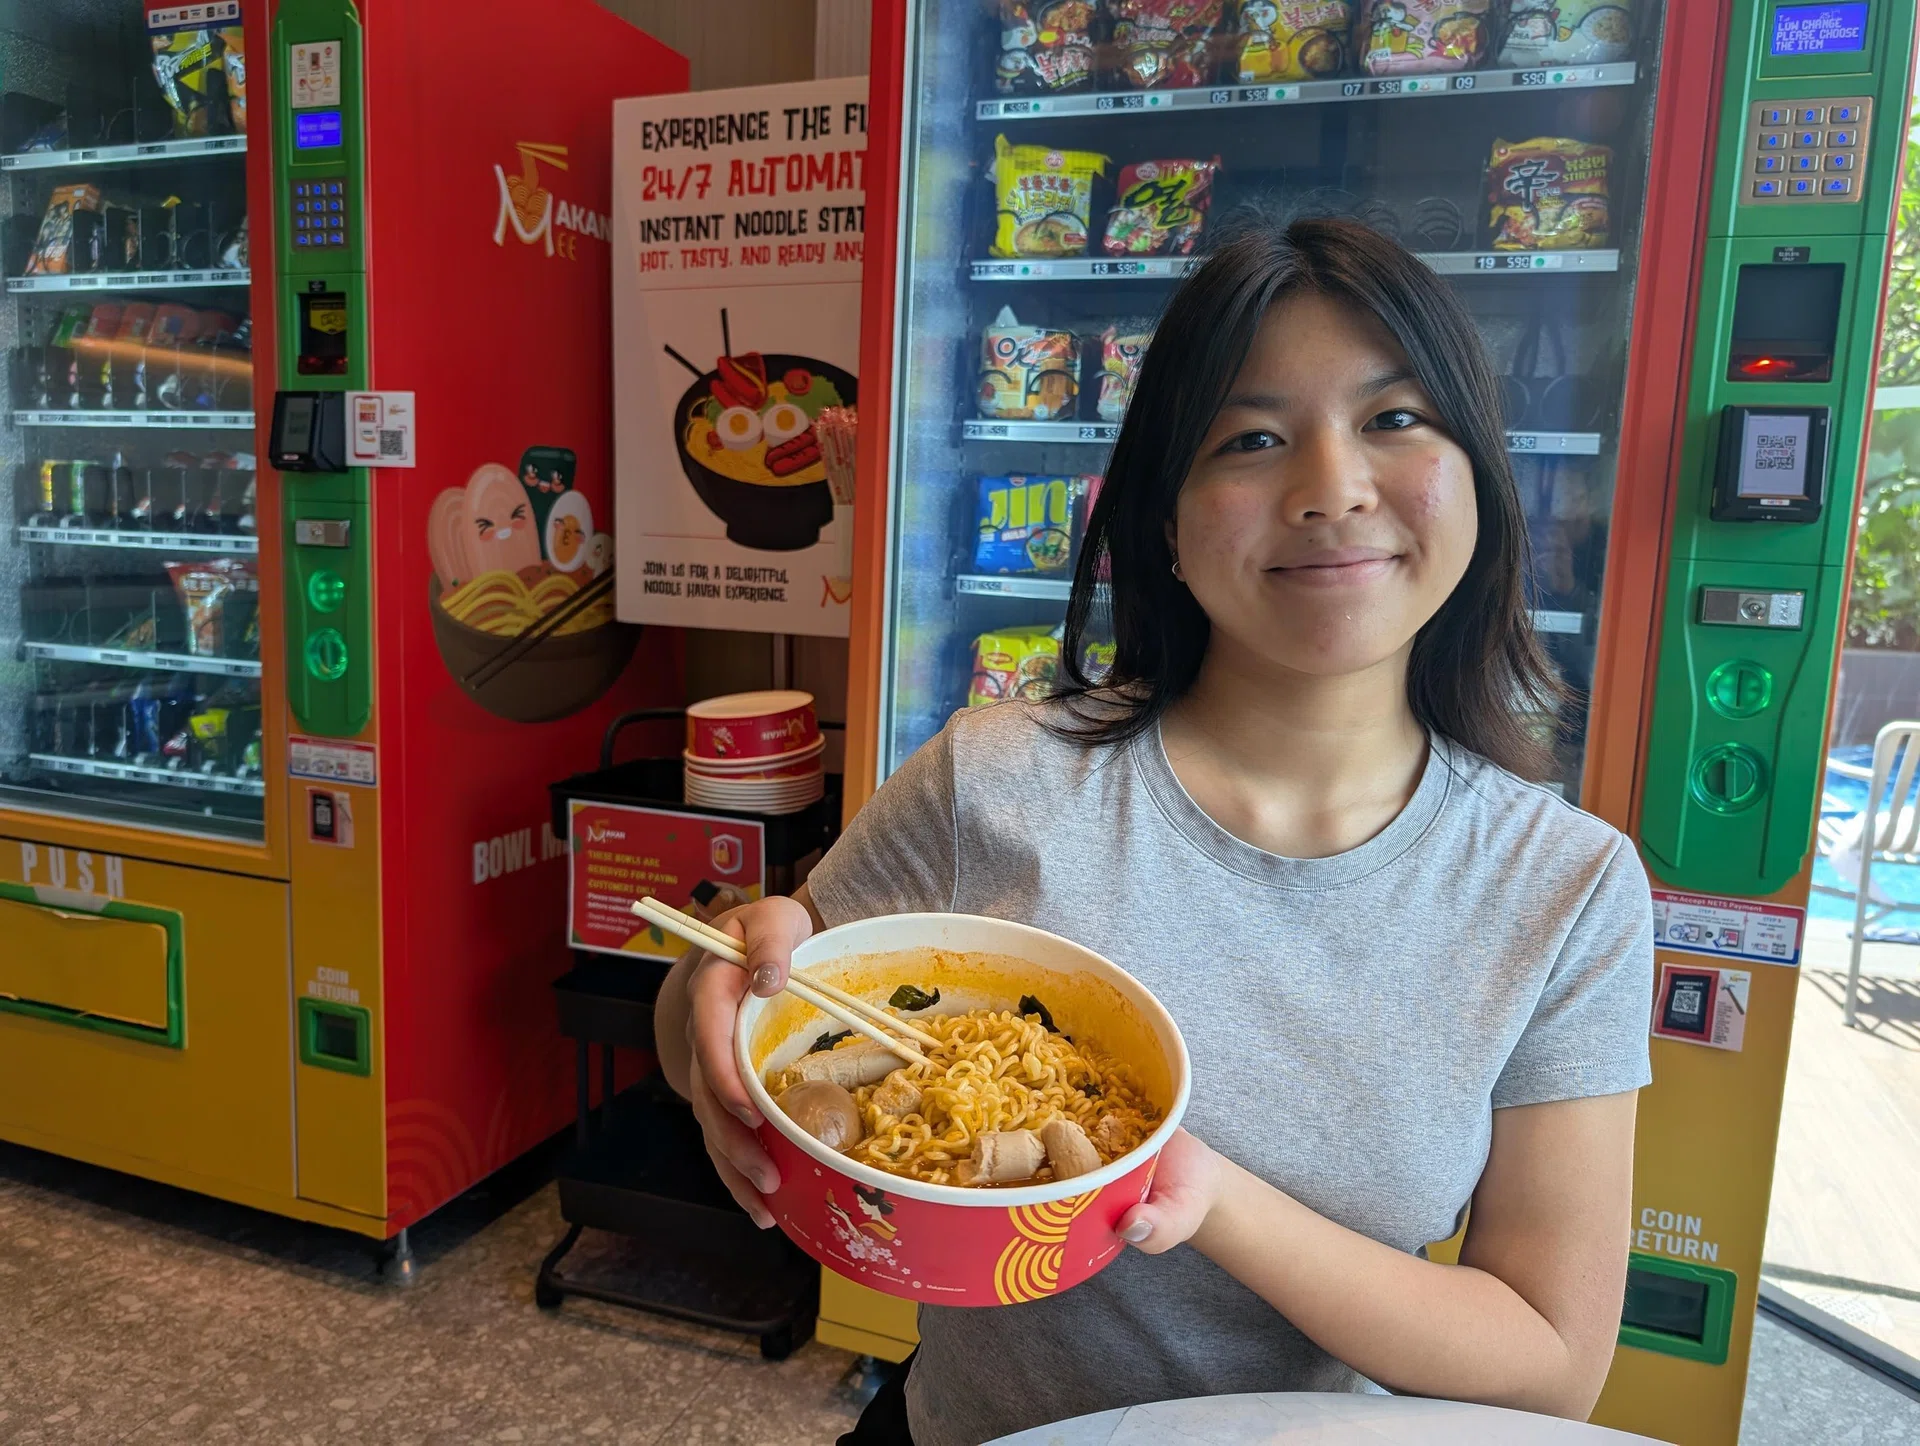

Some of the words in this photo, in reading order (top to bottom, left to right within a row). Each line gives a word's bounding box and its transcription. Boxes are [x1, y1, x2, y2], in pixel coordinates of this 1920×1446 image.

[1778, 21, 1799, 31] LOW
[1801, 18, 1842, 30] CHANGE
[1776, 30, 1815, 40] PLEASE
[1819, 27, 1859, 38] CHOOSE
[1776, 41, 1794, 52] THE
[1797, 40, 1823, 50] ITEM
[1344, 84, 1361, 96] 07
[1456, 76, 1473, 89] 09
[1098, 98, 1114, 109] 03
[1211, 92, 1229, 103] 05
[642, 111, 770, 152] EXPERIENCE
[783, 103, 831, 141] THE
[641, 163, 713, 202] 24/7
[1503, 158, 1560, 213] 辛
[640, 213, 724, 245] INSTANT
[735, 209, 808, 240] NOODLE
[740, 244, 771, 266] AND
[779, 241, 826, 267] READY
[1094, 263, 1108, 274] 13
[1477, 257, 1495, 269] 19
[968, 425, 980, 435] 21
[1081, 428, 1096, 439] 23
[643, 561, 667, 576] JOIN
[690, 564, 709, 580] FOR
[714, 565, 720, 579] A
[726, 566, 789, 584] DELIGHTFUL
[644, 580, 681, 597] NOODLE
[687, 582, 720, 599] HAVEN
[473, 828, 536, 885] BOWL
[588, 850, 613, 861] THESE
[615, 853, 641, 865] BOWLS
[643, 857, 660, 868] ARE
[21, 842, 124, 898] PUSH
[588, 864, 629, 879] RESERVED
[631, 870, 647, 881] FOR
[648, 872, 678, 885] PAYING
[588, 879, 634, 893] CUSTOMERS
[1680, 895, 1705, 905] Accept
[1729, 902, 1762, 912] Payment
[317, 965, 349, 985] COIN
[1641, 1207, 1702, 1236] COIN
